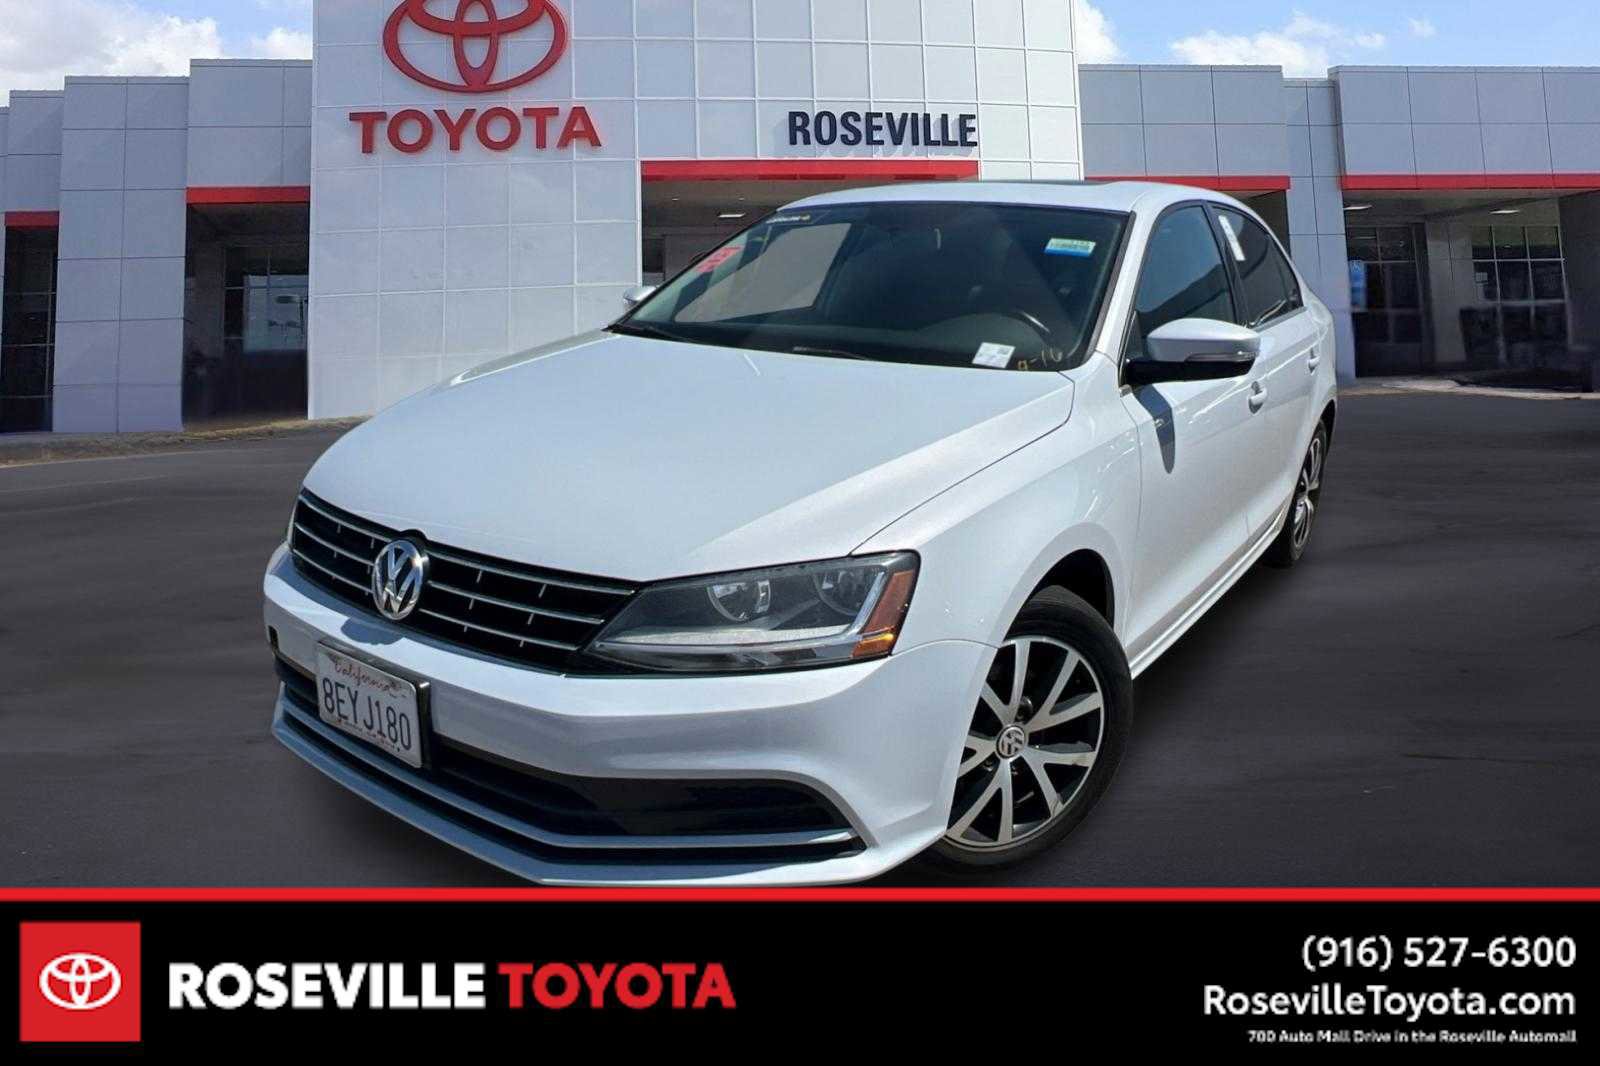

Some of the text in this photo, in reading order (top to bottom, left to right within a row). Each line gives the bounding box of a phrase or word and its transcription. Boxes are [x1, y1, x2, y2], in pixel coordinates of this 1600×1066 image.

[349, 105, 602, 154] TOYOTA
[788, 111, 978, 147] ROSEVILLE
[322, 677, 412, 751] 8EYJ180
